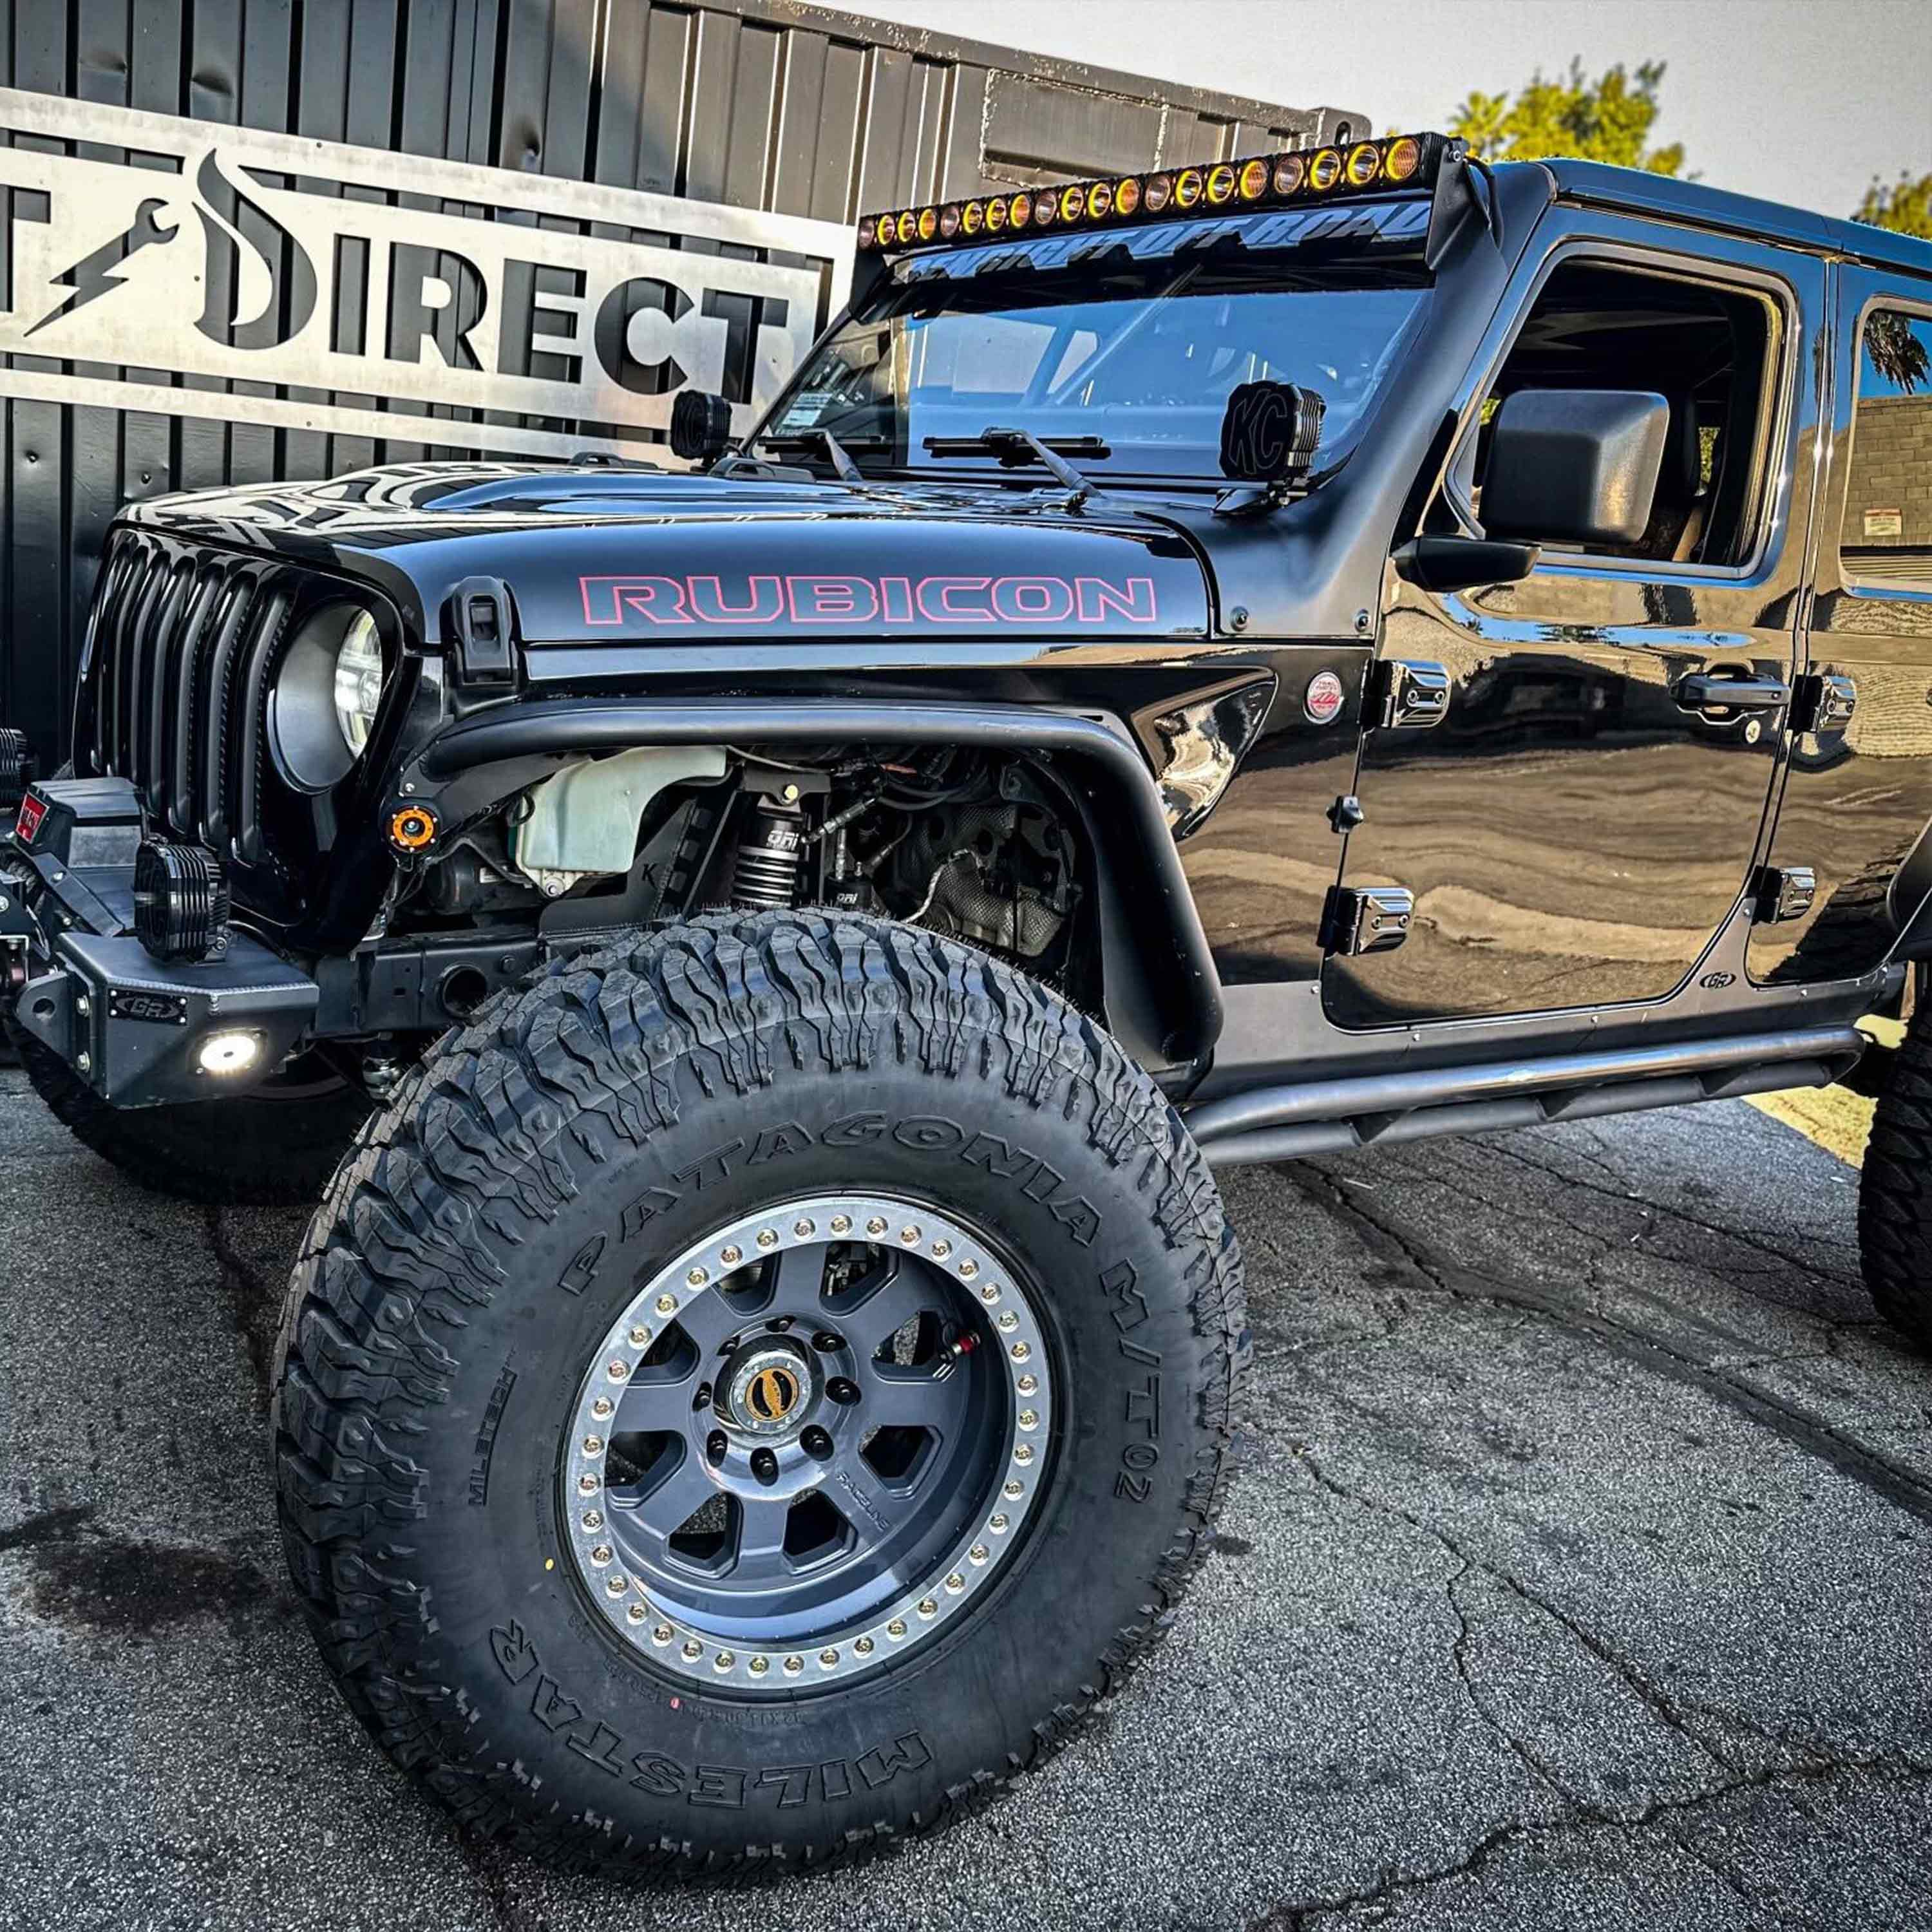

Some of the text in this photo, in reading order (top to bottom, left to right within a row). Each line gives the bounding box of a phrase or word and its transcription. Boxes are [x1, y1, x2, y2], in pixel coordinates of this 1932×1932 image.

[192, 147, 790, 404] DIRECT
[1240, 201, 1432, 247] ROAD
[1228, 388, 1287, 475] KC
[578, 576, 1157, 624] RUBICON
[558, 1110, 1103, 1296] PATAGONIA
[489, 1618, 933, 1809] MILESTAR
